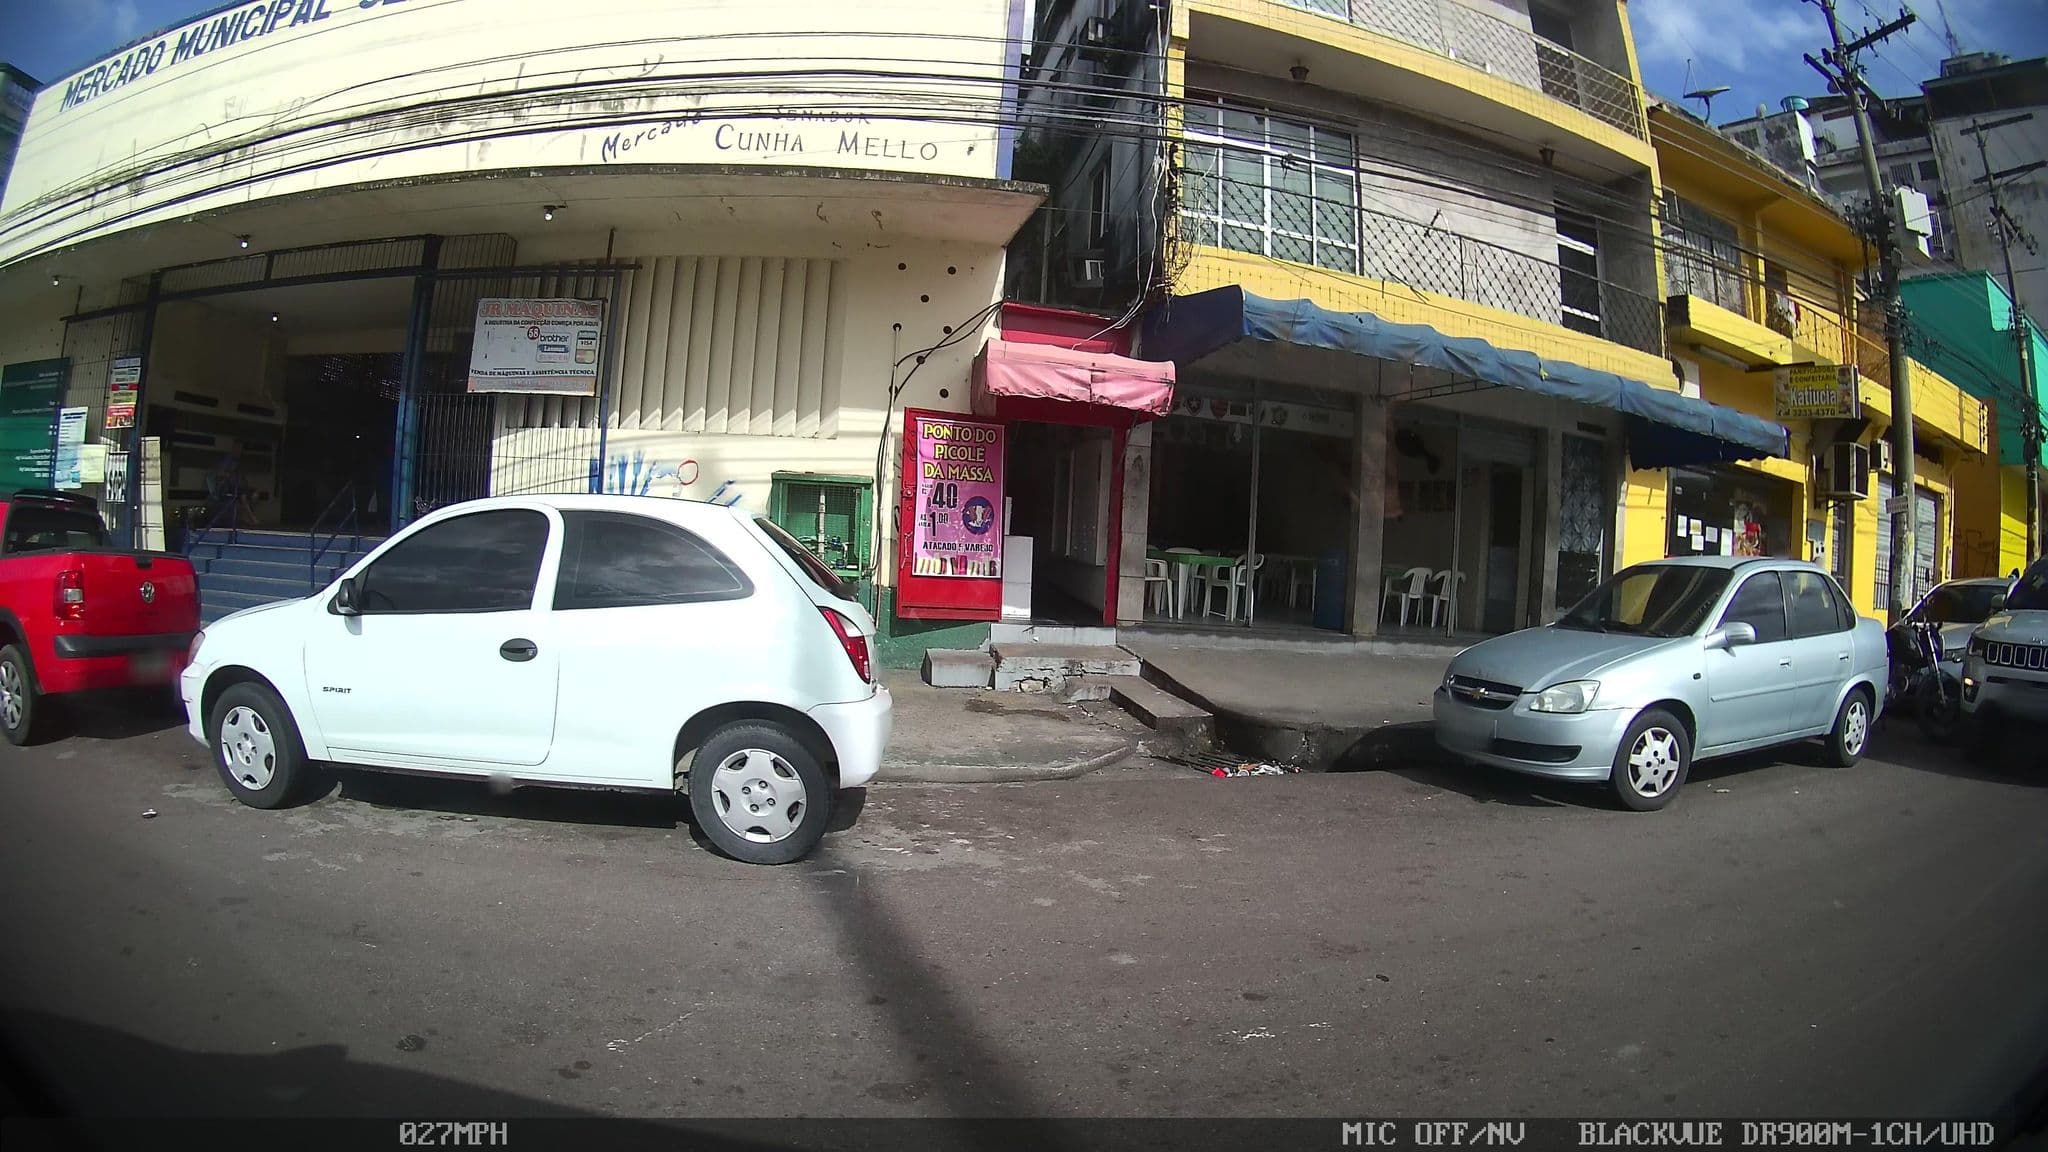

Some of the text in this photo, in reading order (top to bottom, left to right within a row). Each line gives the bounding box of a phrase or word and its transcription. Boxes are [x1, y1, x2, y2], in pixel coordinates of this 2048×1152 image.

[59, 0, 332, 113] MERCADO MUNICIPAL
[601, 108, 702, 163] Mercado
[715, 123, 938, 161] CUNHA MELLO
[481, 301, 501, 318] JR
[1790, 384, 1837, 407] Katiucia
[922, 423, 996, 444] PONTO DO
[933, 444, 985, 462] PICOLÉ
[923, 463, 994, 482] DA MASSA
[923, 541, 957, 551] ATACADO
[964, 542, 993, 553] VAREJO
[322, 686, 352, 694] SPIRIT
